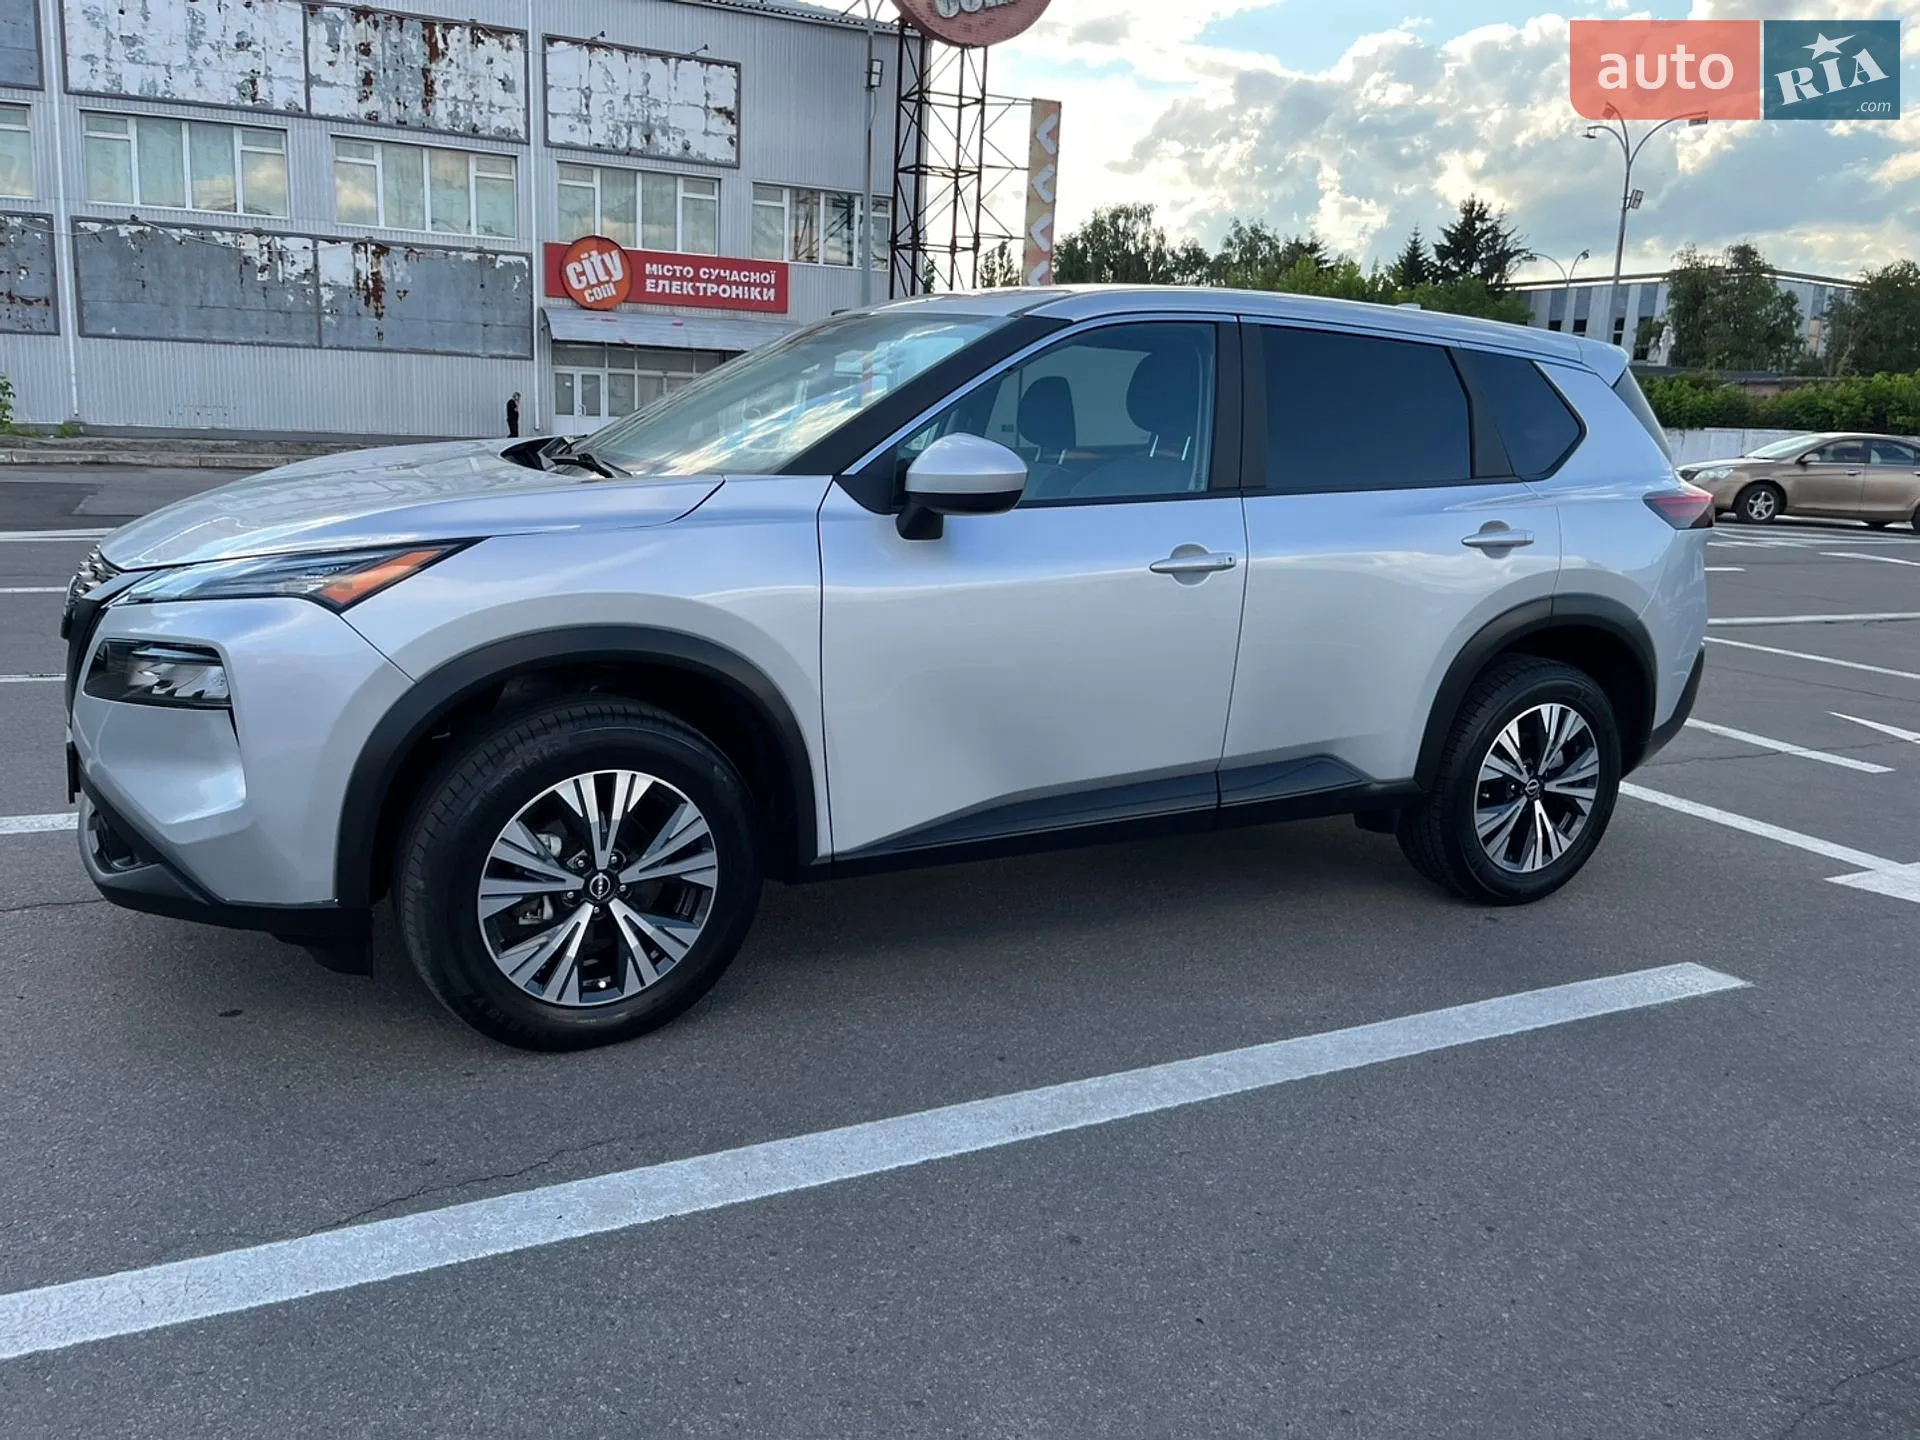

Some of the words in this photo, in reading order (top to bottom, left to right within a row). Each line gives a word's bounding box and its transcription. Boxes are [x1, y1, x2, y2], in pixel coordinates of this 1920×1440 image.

[645, 263, 694, 278] МІСТО
[699, 267, 776, 285] СУЧАСНОЇ
[584, 282, 617, 303] com
[645, 278, 776, 301] ЕЛЕКТРОНІКИ
